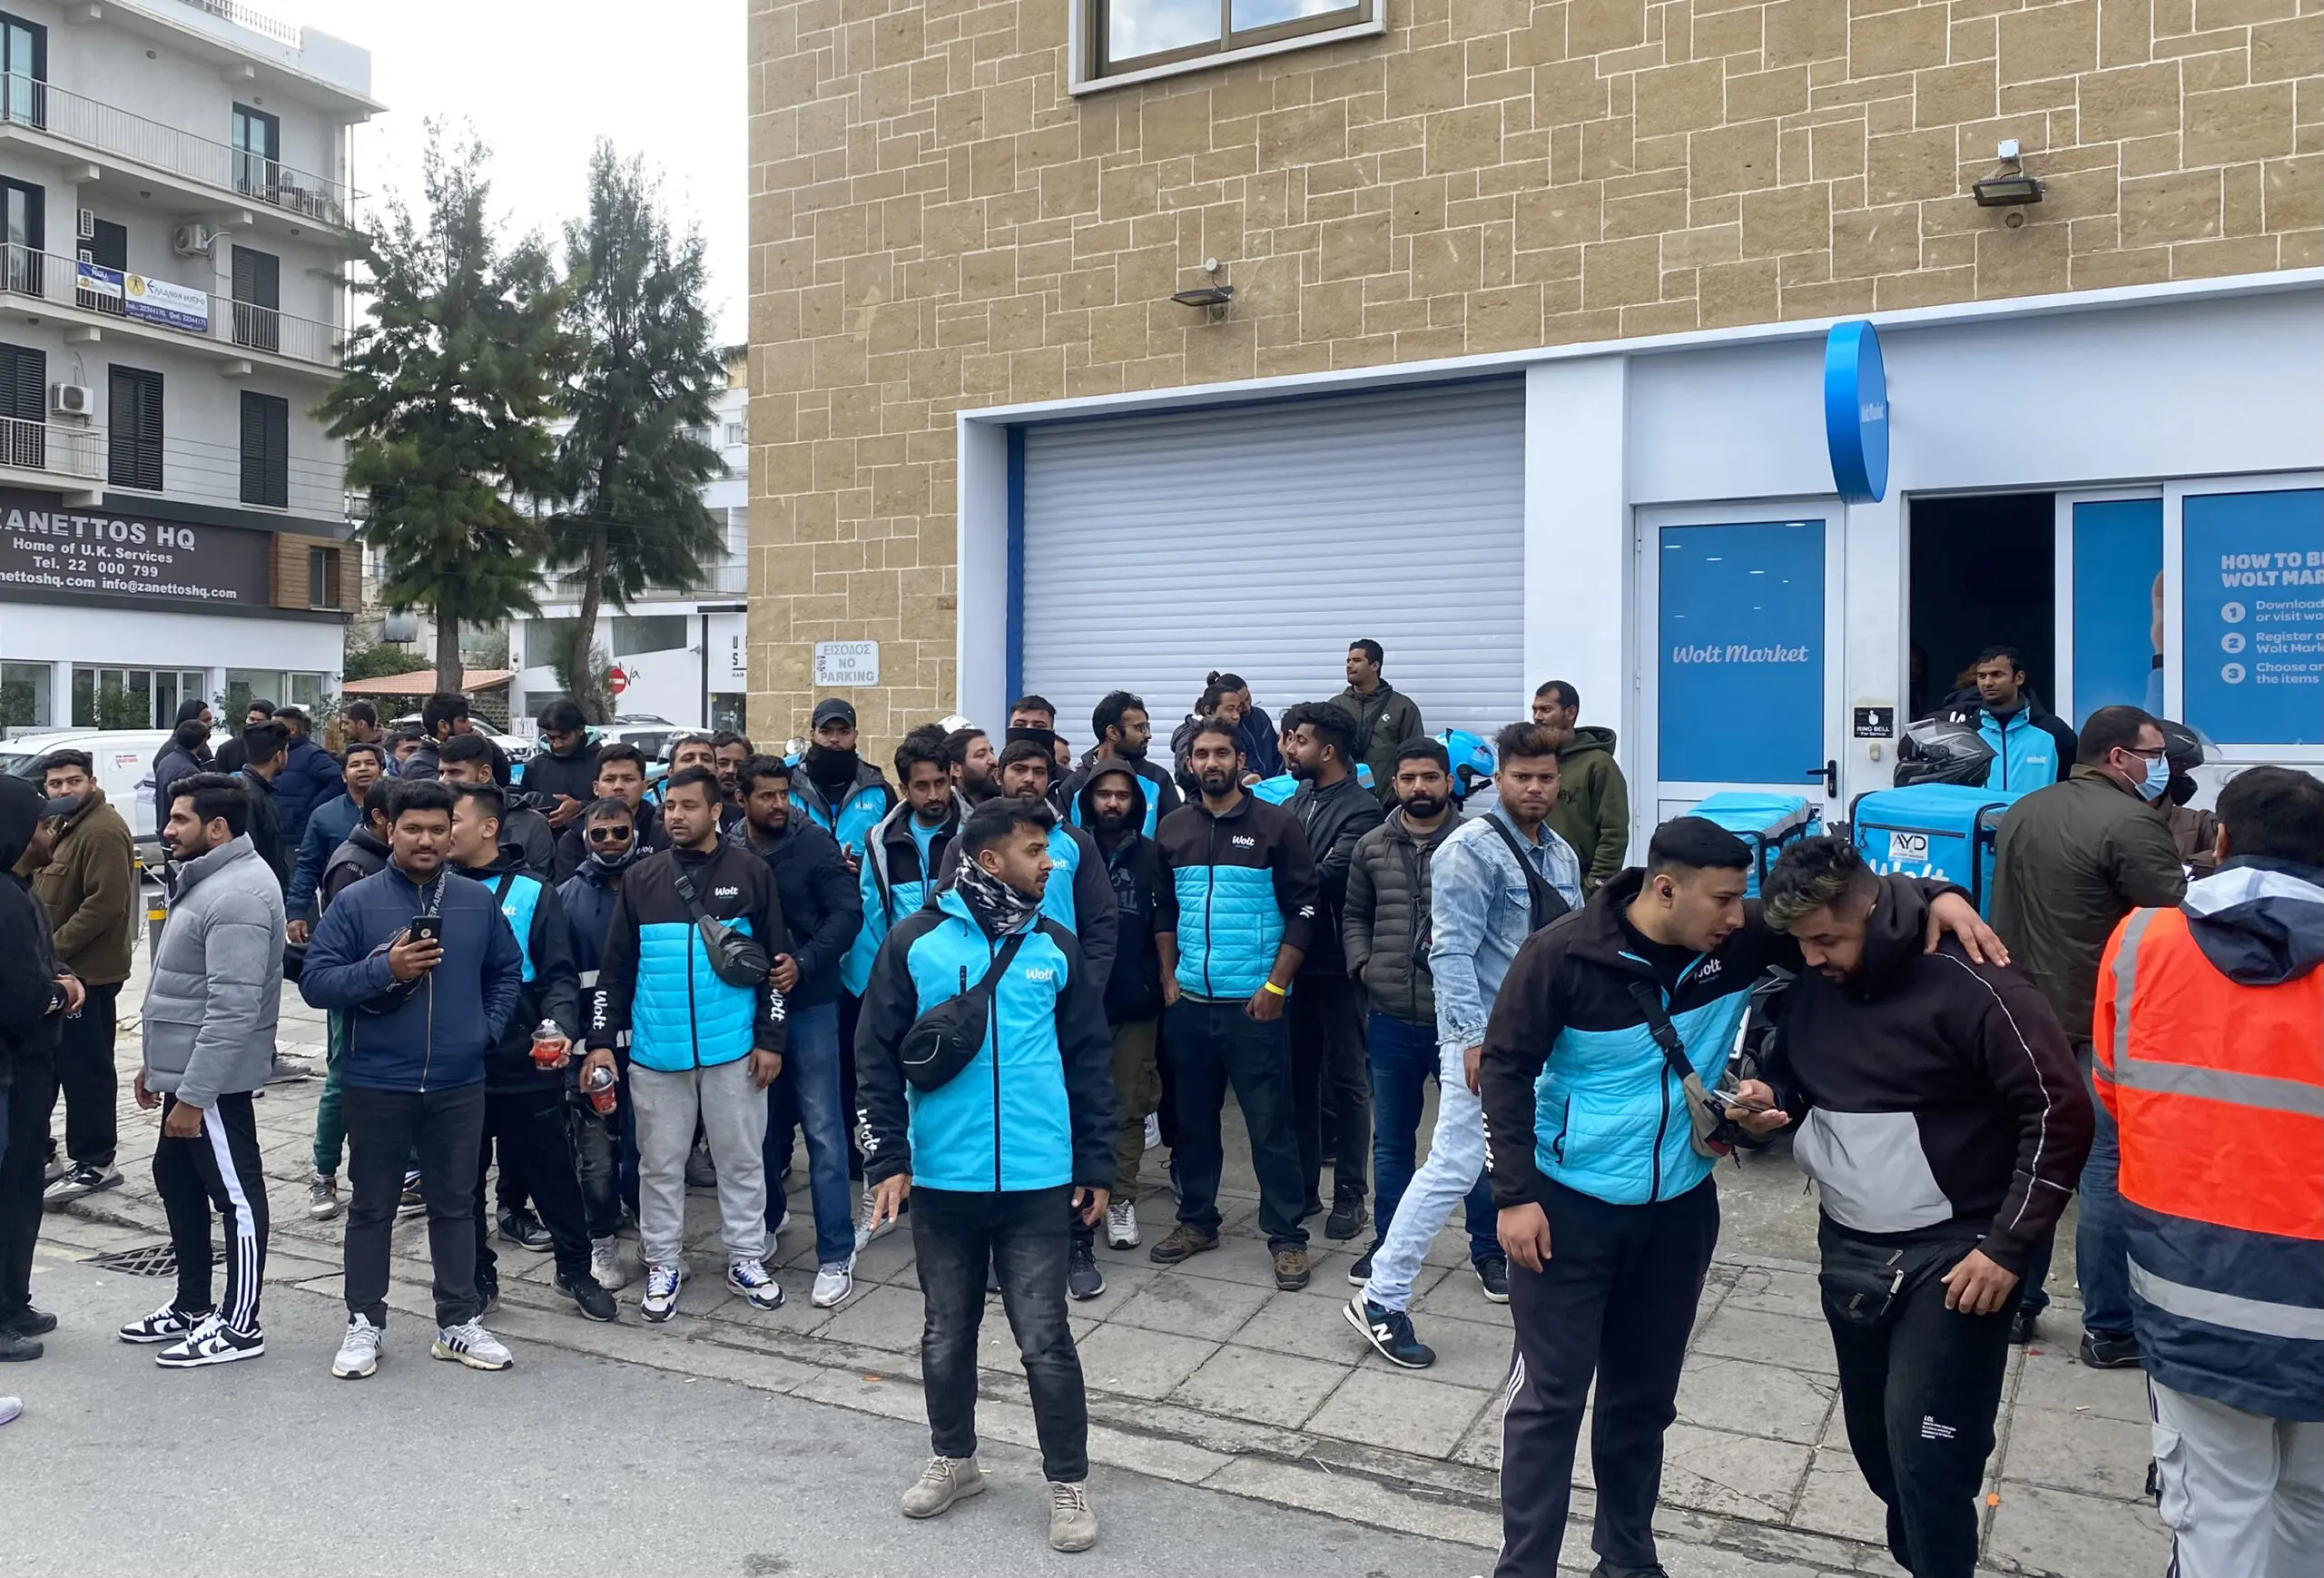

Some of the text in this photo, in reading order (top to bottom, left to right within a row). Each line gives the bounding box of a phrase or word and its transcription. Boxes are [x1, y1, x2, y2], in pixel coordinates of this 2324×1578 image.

[0, 508, 195, 551] ANETTOS HQ
[13, 537, 172, 563] Home of U.K. Services
[33, 556, 158, 577] Tel. 22 000 799
[2221, 551, 2324, 570] HOW TO B
[2221, 571, 2279, 587] WOLT
[102, 577, 237, 599] info@zanettoshq.com
[2229, 607, 2237, 618] 1
[2256, 614, 2270, 622] or
[2273, 611, 2301, 621] visit
[2229, 637, 2239, 649] 2
[2256, 631, 2313, 644] Register
[823, 644, 871, 655] ΕΙΣΟΔΟΣ
[1673, 644, 1809, 663] Wolt Market
[2256, 644, 2288, 653] Wolt
[838, 658, 856, 668] NO
[2256, 662, 2307, 672] Choose
[821, 671, 875, 682] PARKING
[2229, 668, 2239, 678] 3
[2256, 673, 2319, 684] the items
[1232, 835, 1256, 846] Wolt
[1892, 833, 1926, 851] AYD
[715, 886, 739, 896] Wolt
[1026, 968, 1053, 981] Wolt
[593, 990, 608, 1030] Wolt
